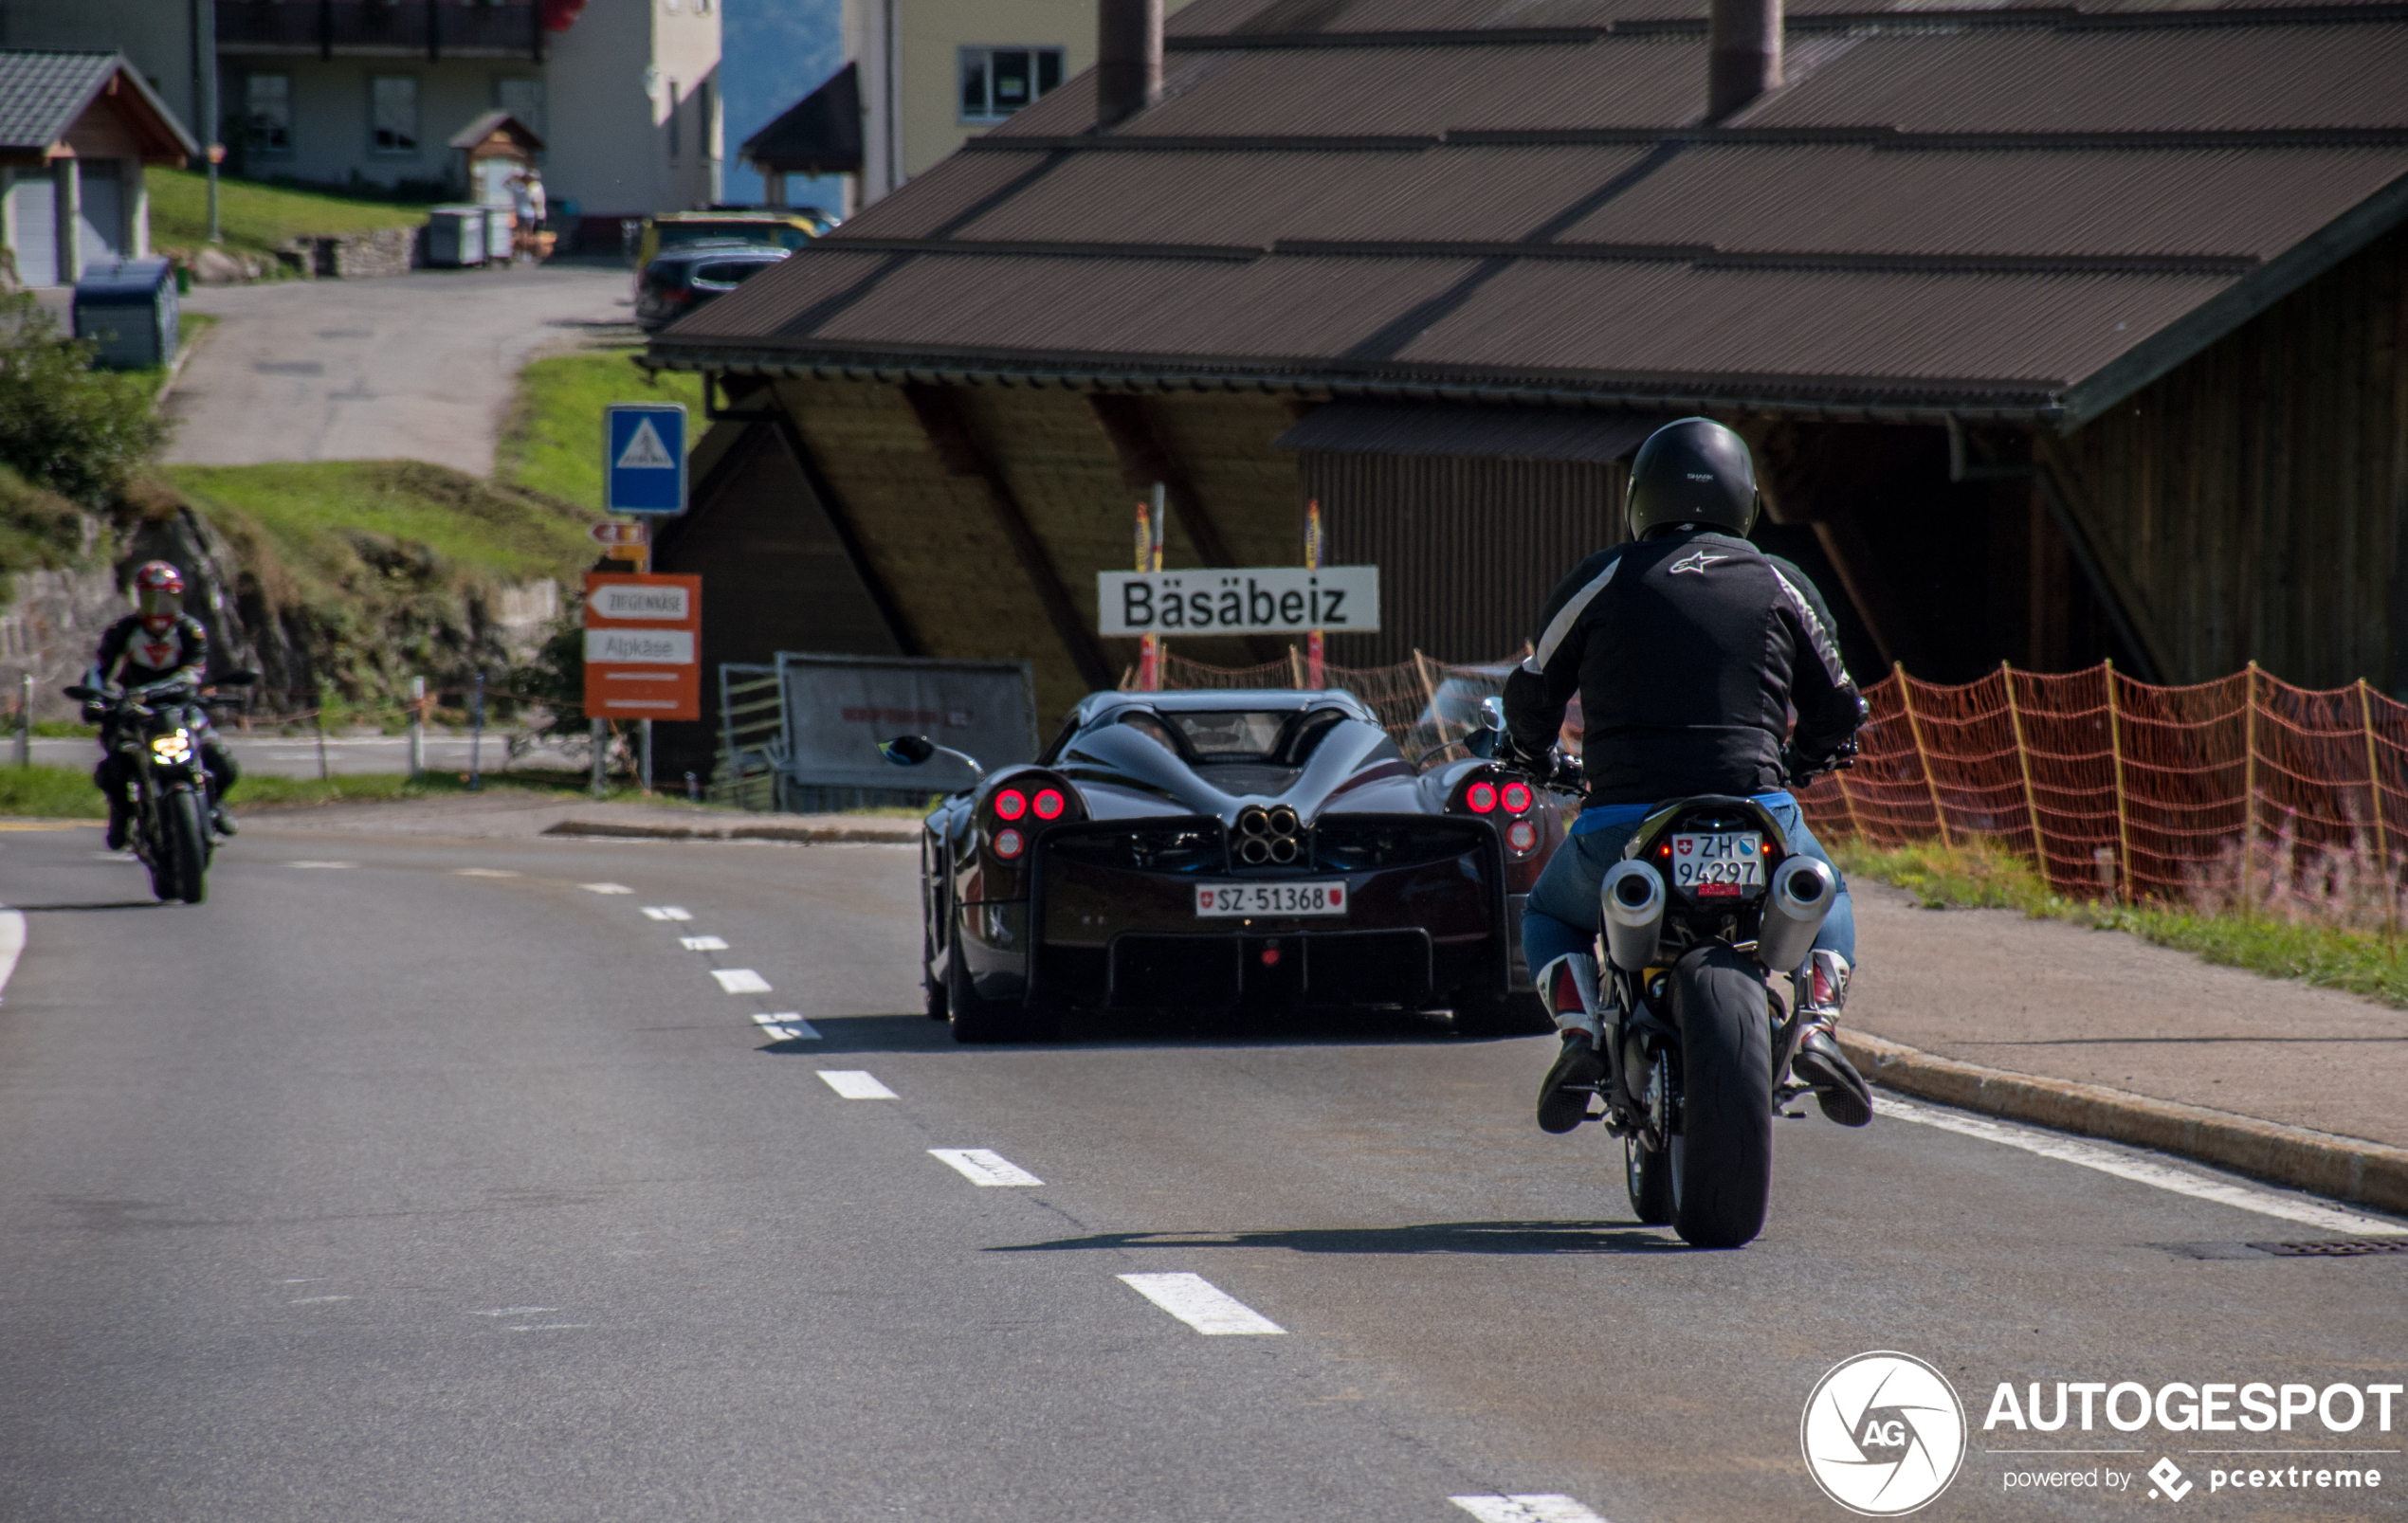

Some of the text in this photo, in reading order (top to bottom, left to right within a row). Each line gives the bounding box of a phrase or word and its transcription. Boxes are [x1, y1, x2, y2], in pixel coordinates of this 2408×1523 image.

[1122, 576, 1348, 627] Bäsäbeiz
[606, 636, 674, 658] Alpkäse
[1700, 836, 1734, 858] ZH
[1679, 861, 1758, 885] 94297
